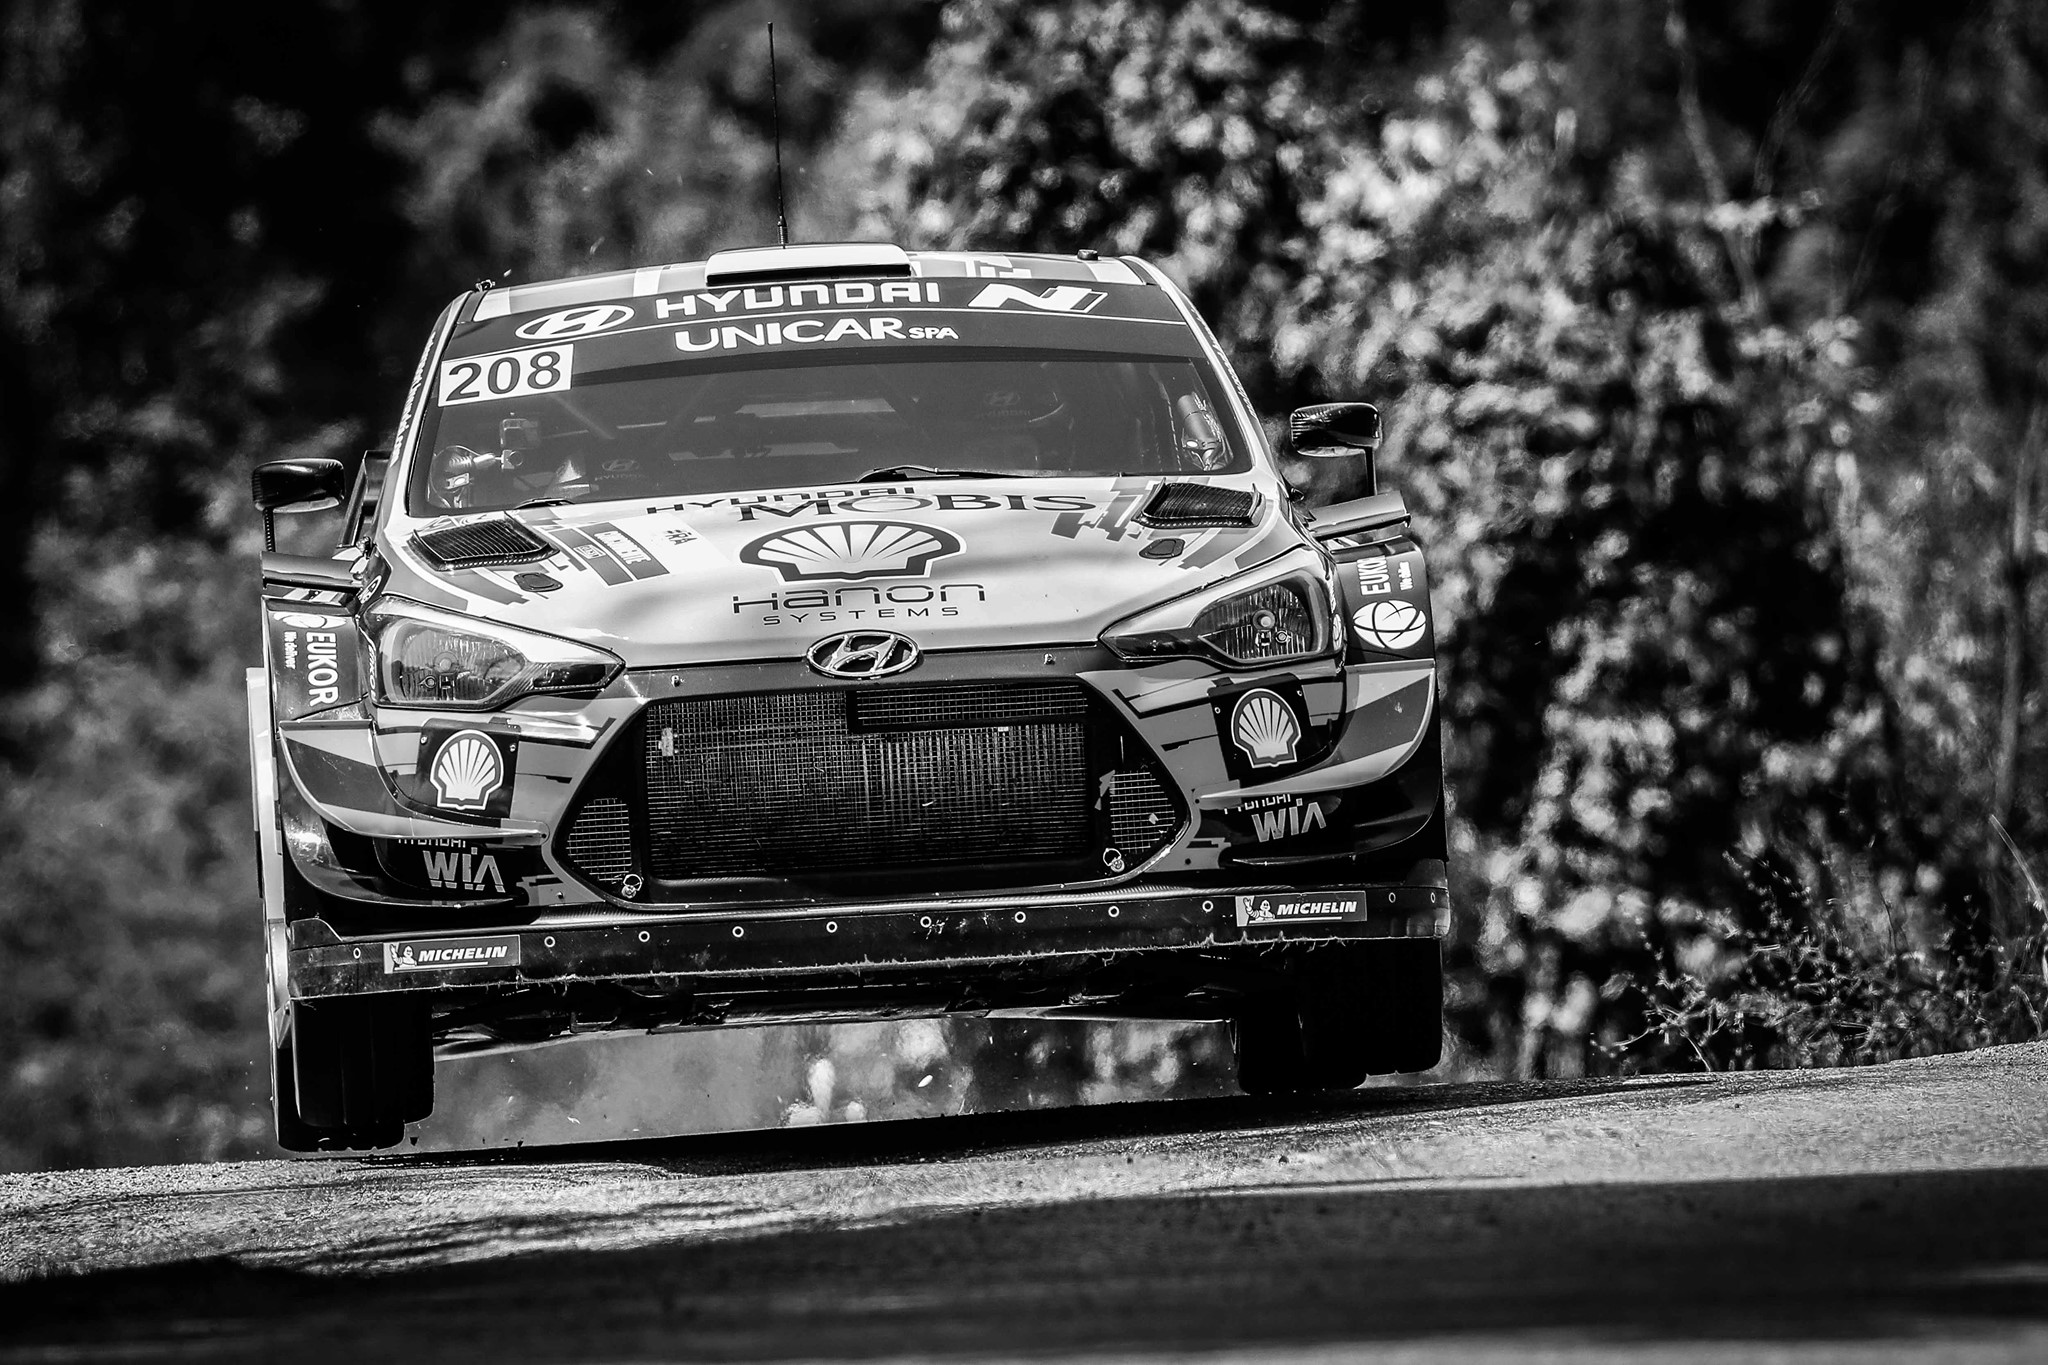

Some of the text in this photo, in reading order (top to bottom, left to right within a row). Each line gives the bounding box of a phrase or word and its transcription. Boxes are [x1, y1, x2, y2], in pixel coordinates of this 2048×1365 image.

[655, 281, 941, 319] HYUNDAI
[675, 317, 907, 352] UNICAR
[445, 350, 562, 402] 208
[737, 493, 1098, 522] MOBIS
[763, 605, 960, 627] SYSTEMS
[306, 631, 340, 707] EUKOR
[1277, 901, 1357, 916] MICHELIN
[418, 945, 508, 963] MICHELIN
